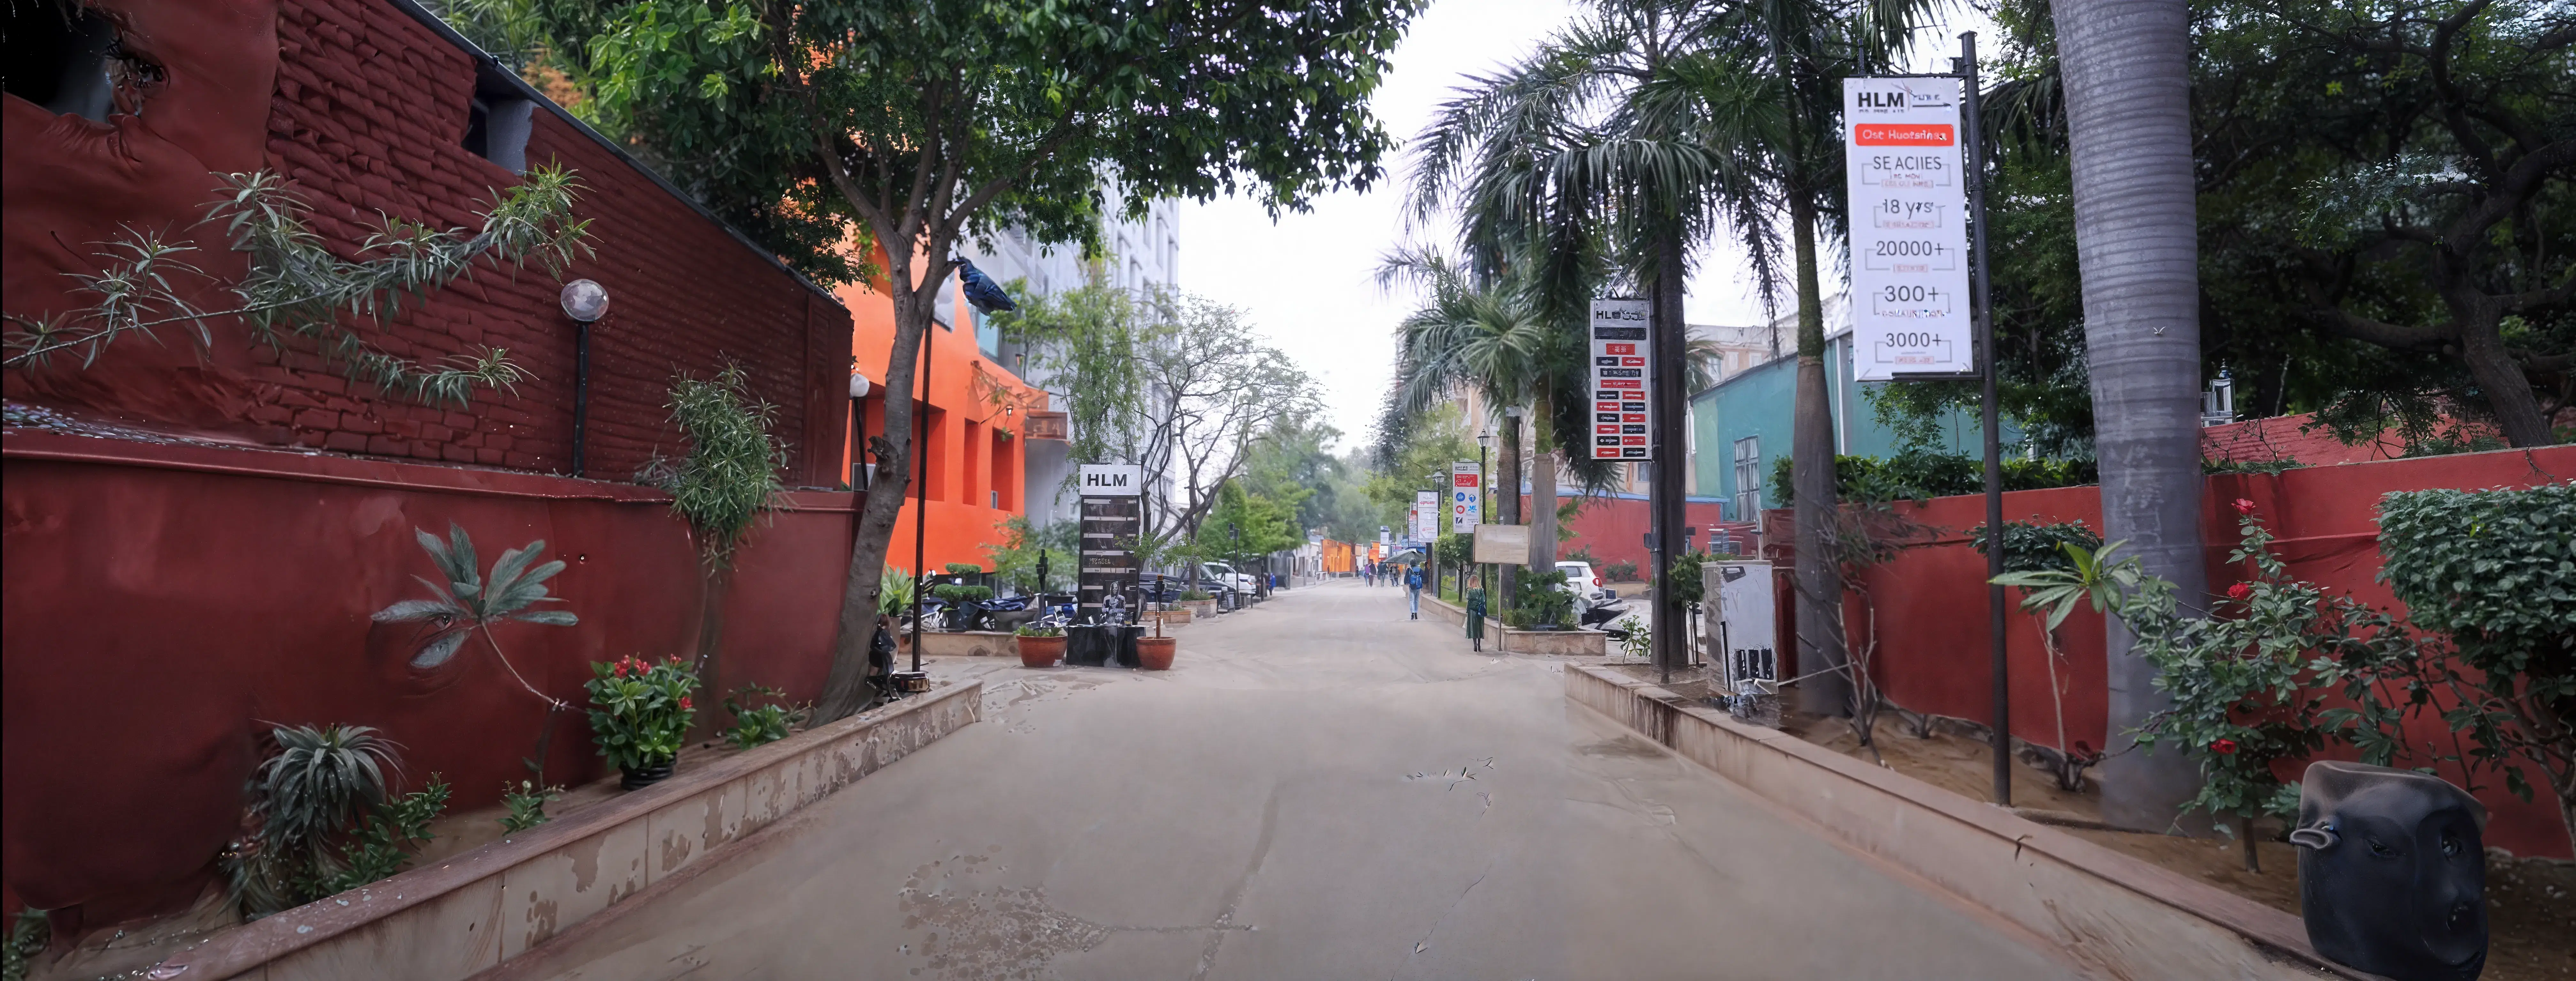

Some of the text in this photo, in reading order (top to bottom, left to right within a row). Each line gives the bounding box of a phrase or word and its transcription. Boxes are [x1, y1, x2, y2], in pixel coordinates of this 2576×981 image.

[1858, 92, 1903, 107] HLM
[1883, 199, 1900, 213] 18
[1876, 241, 1944, 256] 20000+
[1885, 285, 1939, 302] 300+
[1886, 333, 1941, 347] 3000+
[1087, 474, 1127, 486] HLM
